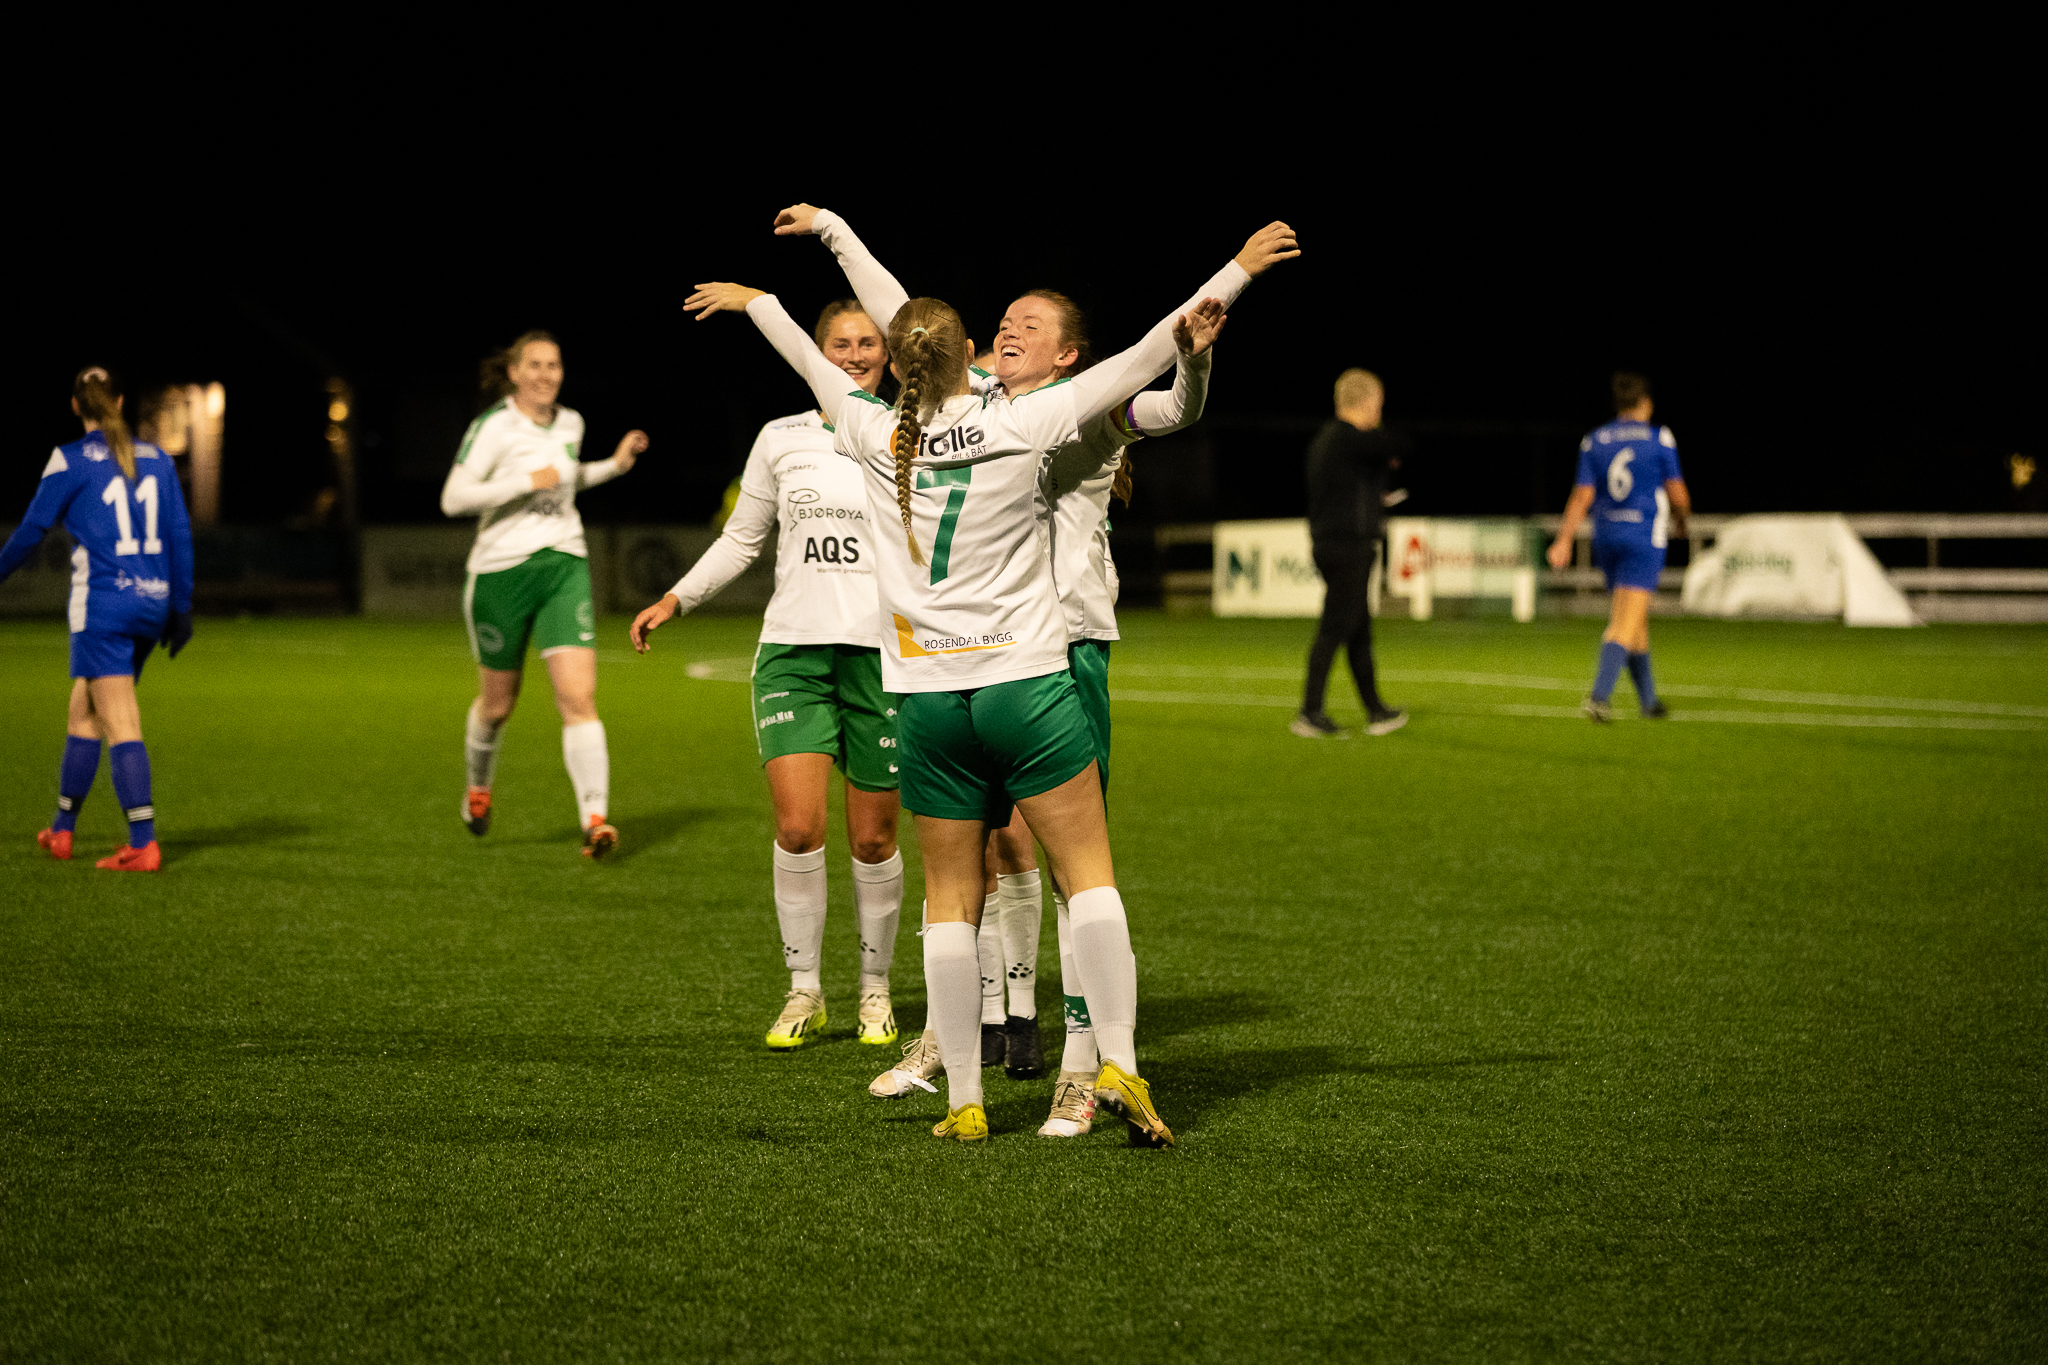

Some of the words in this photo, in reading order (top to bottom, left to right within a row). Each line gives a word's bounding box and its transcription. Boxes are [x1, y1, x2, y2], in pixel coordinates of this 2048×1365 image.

[918, 424, 985, 458] folla
[1607, 446, 1636, 503] 6
[101, 474, 163, 557] 11
[798, 507, 864, 520] BJØRØYA
[916, 465, 972, 587] 7
[803, 536, 860, 565] AQS
[924, 636, 981, 650] ROSENDAL
[982, 631, 1013, 645] BYGG
